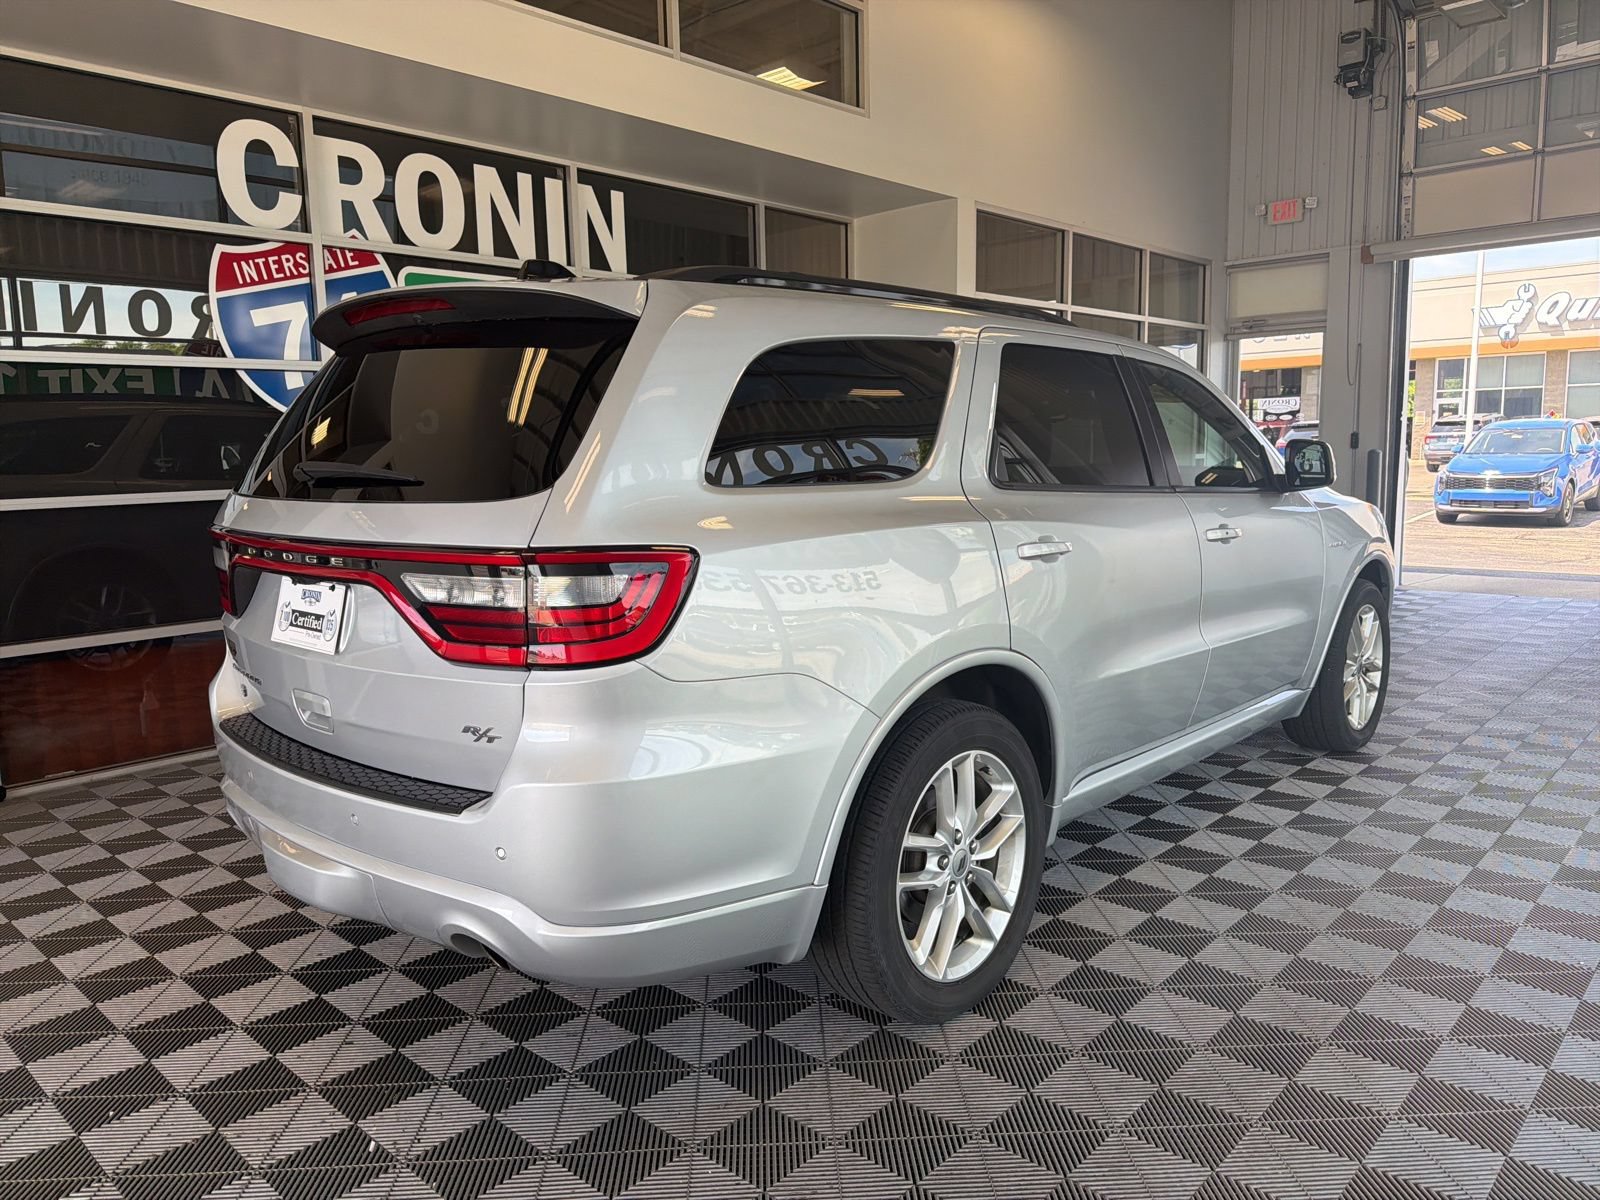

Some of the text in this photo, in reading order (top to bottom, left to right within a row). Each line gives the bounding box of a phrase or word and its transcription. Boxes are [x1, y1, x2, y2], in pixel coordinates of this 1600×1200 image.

[217, 118, 628, 275] CRONIN
[1272, 199, 1297, 224] EXIT
[233, 248, 359, 285] INTERSATE
[1536, 291, 1600, 328] Qu
[247, 547, 343, 567] DODGE
[292, 612, 322, 631] Certified
[461, 725, 503, 743] R/T
